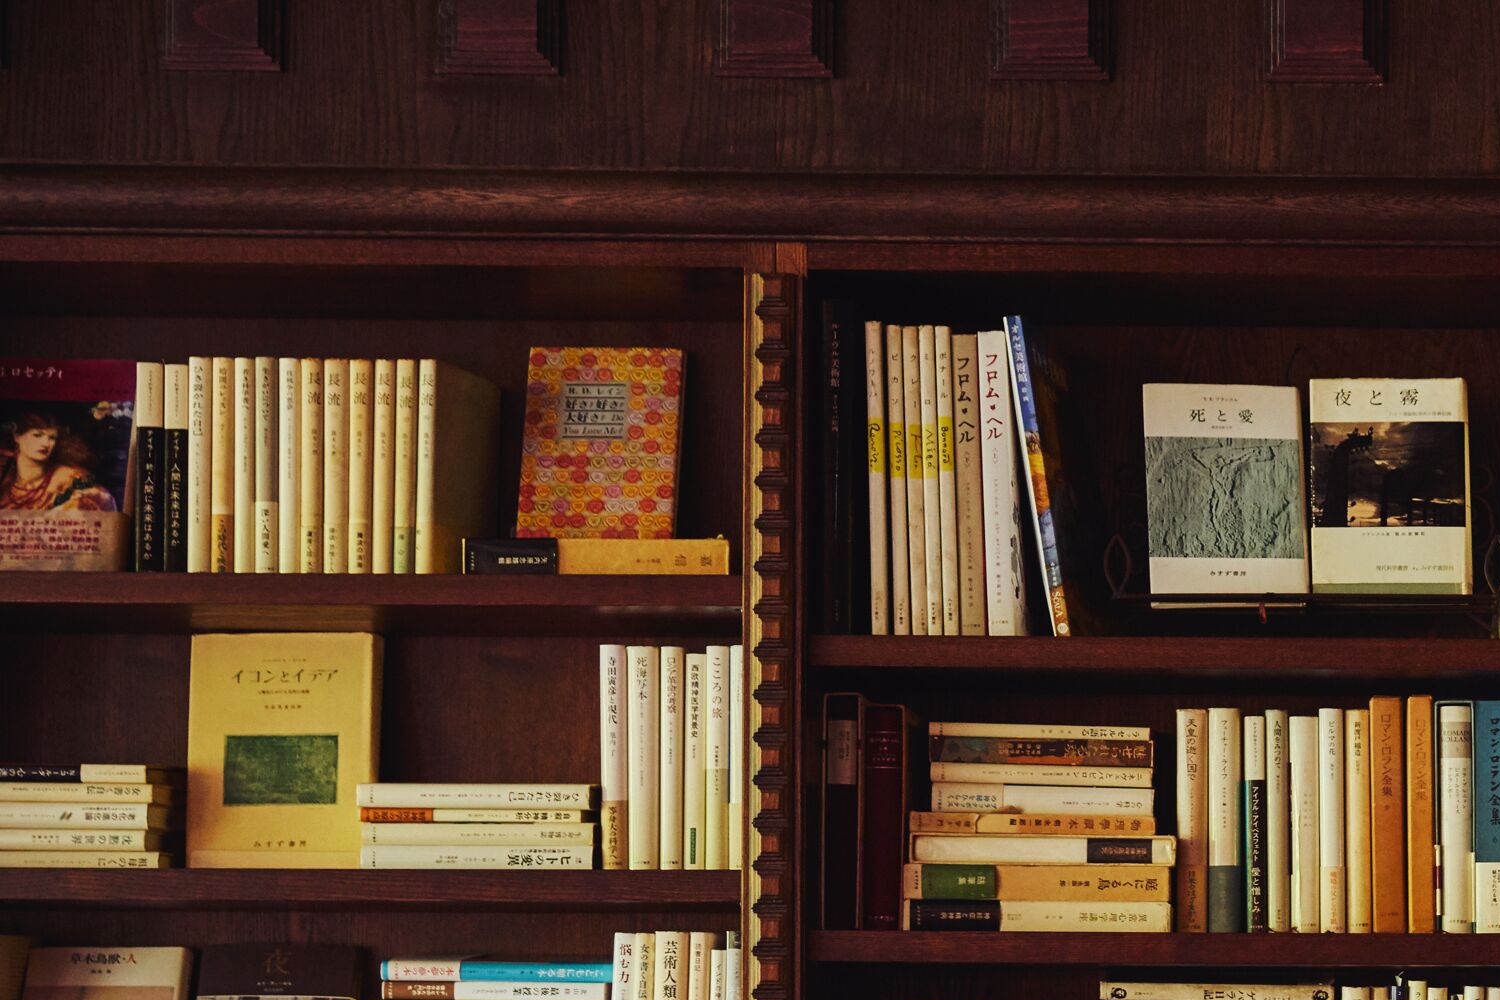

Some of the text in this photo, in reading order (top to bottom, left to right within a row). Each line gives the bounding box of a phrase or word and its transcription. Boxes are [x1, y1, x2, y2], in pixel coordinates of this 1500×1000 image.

[985, 354, 1003, 441] フロム・ヘル
[1334, 388, 1420, 408] 夜と霧
